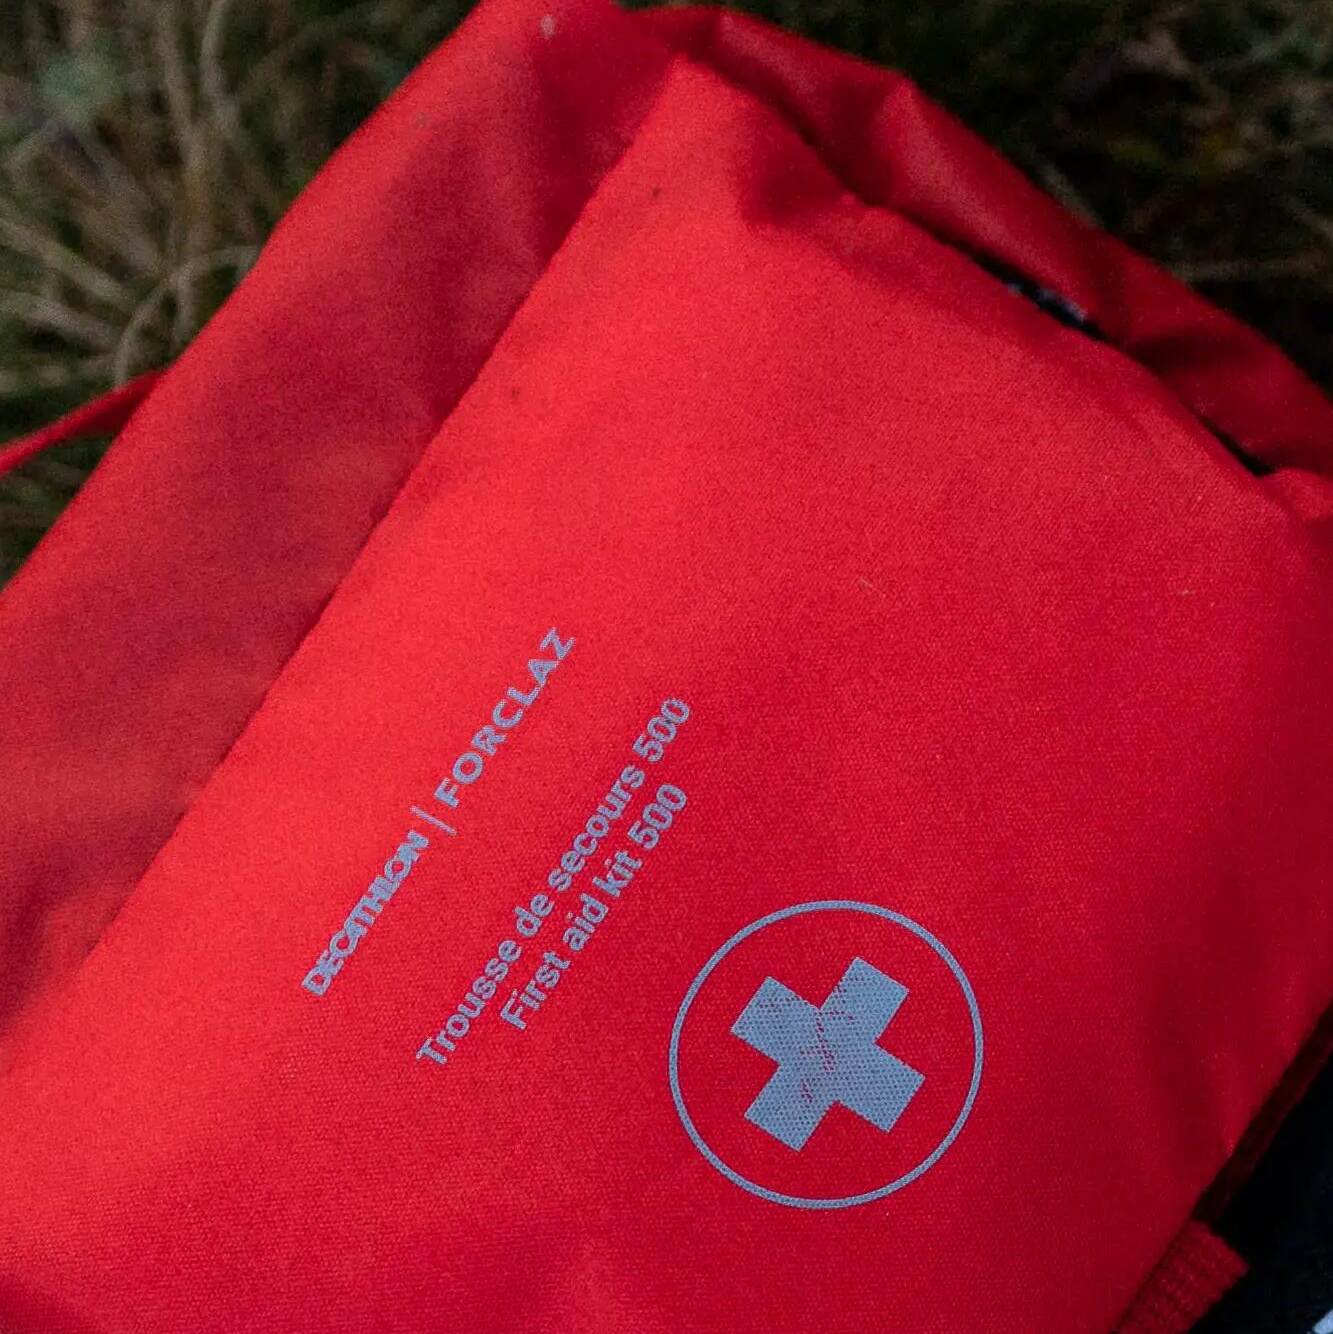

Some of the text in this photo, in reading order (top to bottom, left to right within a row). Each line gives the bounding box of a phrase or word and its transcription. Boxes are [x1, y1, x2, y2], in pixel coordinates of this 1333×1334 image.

[301, 627, 574, 995] DECATHLON FORCLAZ
[416, 697, 692, 1065] Trousse de secours 500
[500, 784, 687, 1030] First aid kit 500
